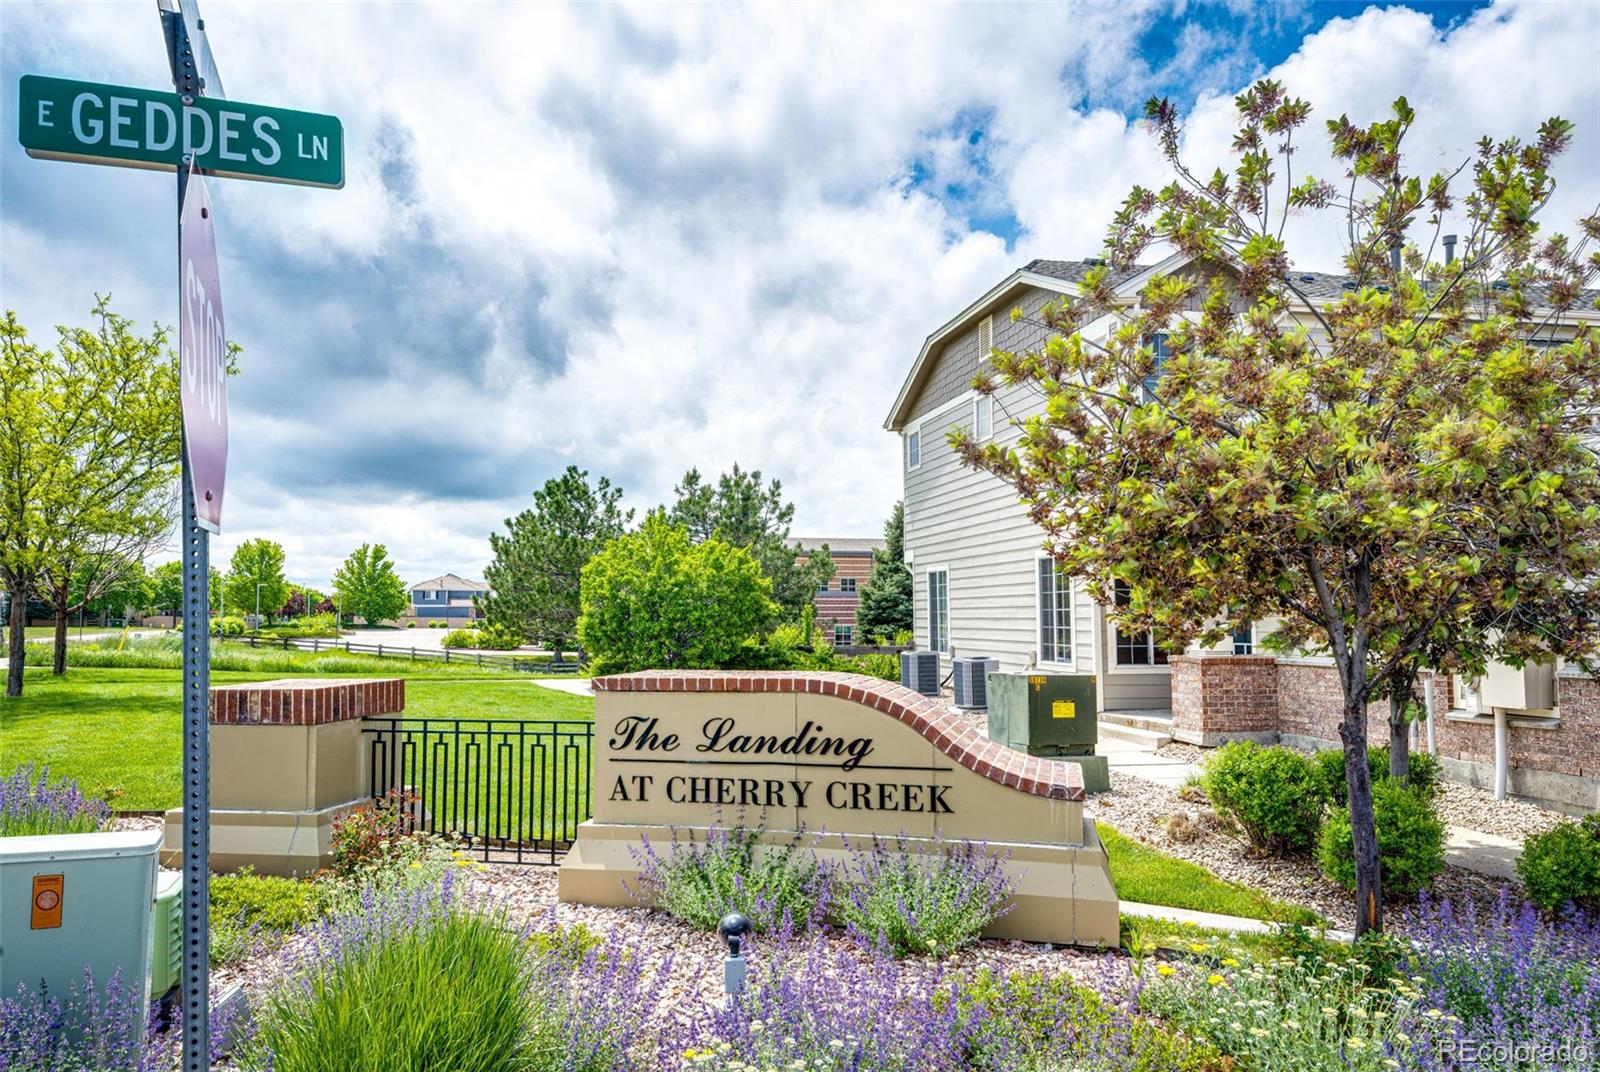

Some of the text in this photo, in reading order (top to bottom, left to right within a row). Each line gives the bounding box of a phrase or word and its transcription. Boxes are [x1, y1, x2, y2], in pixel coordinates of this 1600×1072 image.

[38, 92, 328, 166] E GEDDES LN
[186, 257, 224, 427] STOP
[609, 715, 874, 772] The Landing
[609, 775, 955, 814] AT CHERRY CREEK
